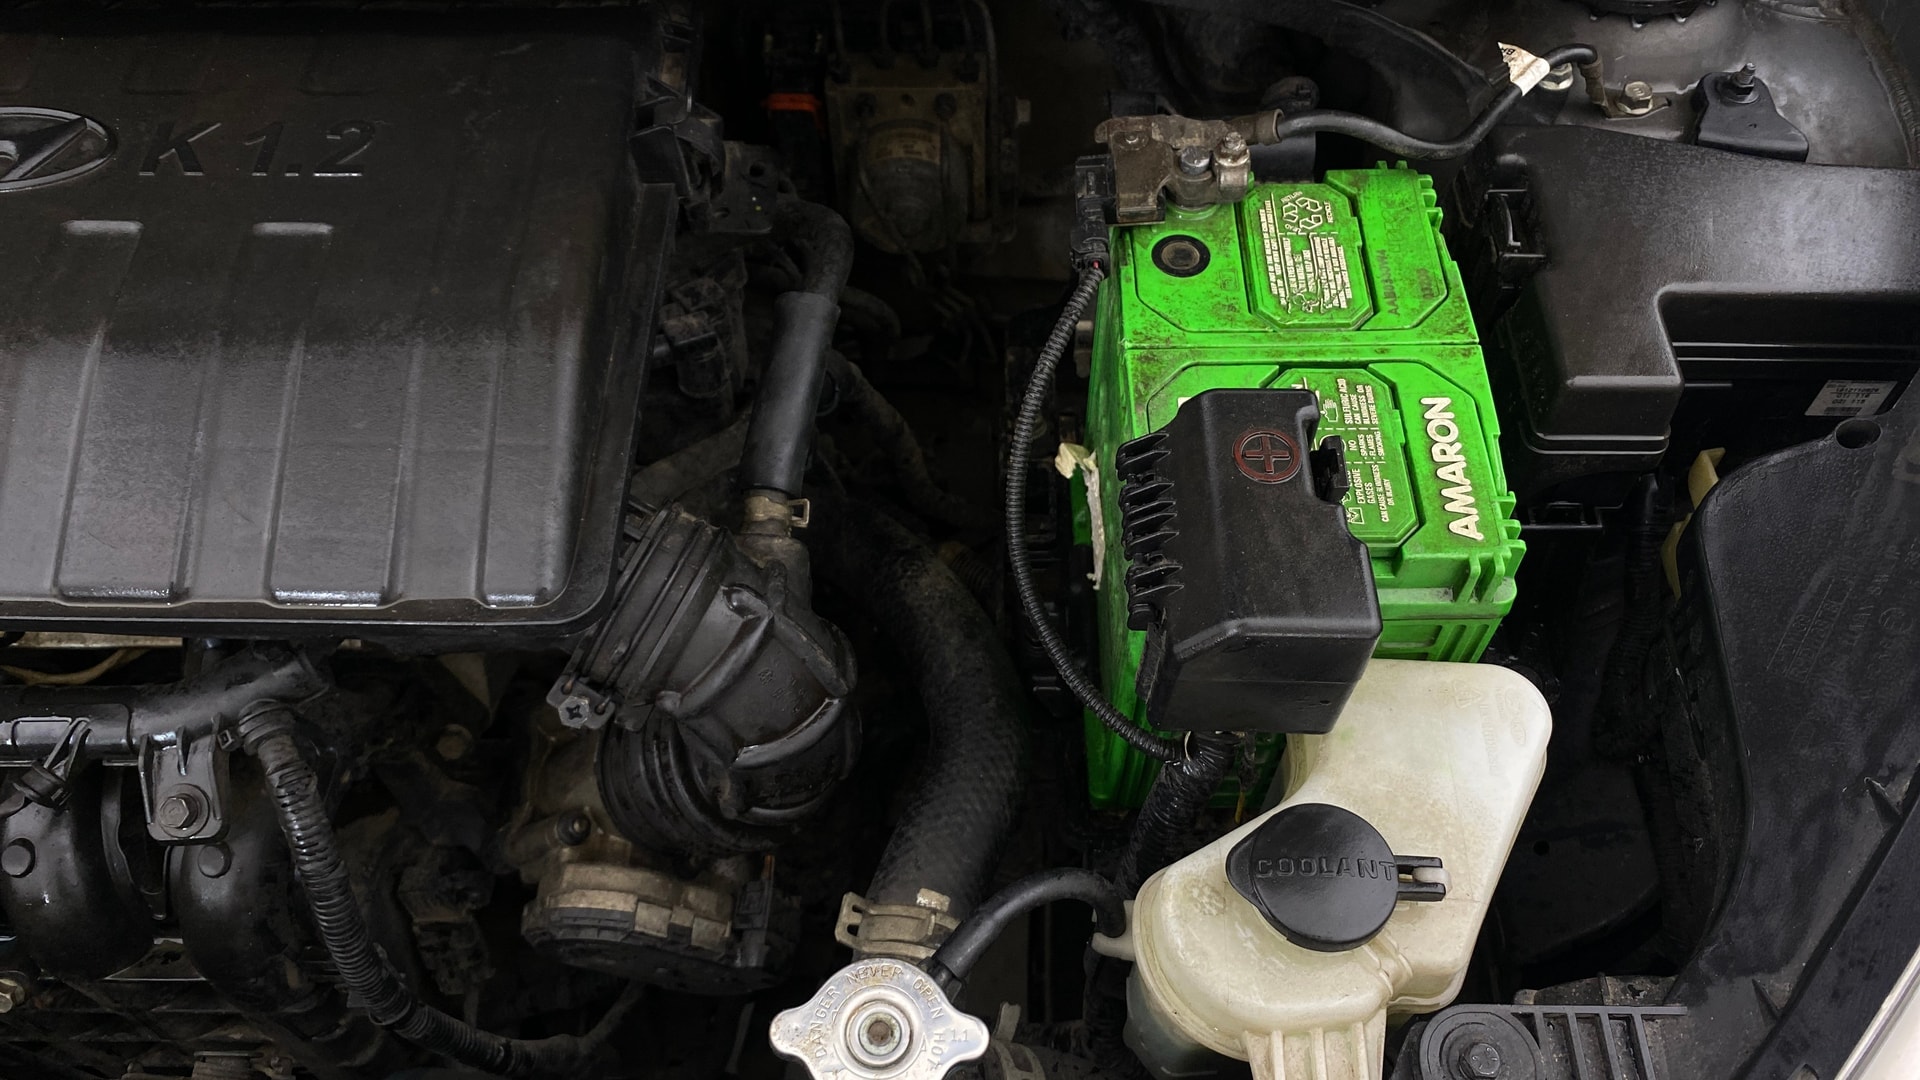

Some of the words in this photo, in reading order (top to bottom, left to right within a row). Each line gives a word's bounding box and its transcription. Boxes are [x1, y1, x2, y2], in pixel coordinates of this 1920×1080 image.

[139, 121, 222, 176] K
[243, 120, 376, 177] 1.2
[1323, 201, 1334, 223] RECYCLE
[1337, 379, 1347, 393] ACID
[1356, 385, 1364, 393] OR
[1365, 385, 1374, 404] BURNS
[1340, 394, 1353, 424] SULFURIC
[1350, 394, 1359, 411] CAUSE
[1358, 395, 1370, 424] BLINDNESS
[1354, 413, 1362, 424] CAN
[1368, 404, 1378, 424] SEVERE
[1348, 439, 1358, 451] NO
[1357, 434, 1368, 456] SPARKS
[1366, 434, 1376, 456] FLAMES
[1374, 431, 1384, 456] SMOKING
[1420, 397, 1484, 541] AMARON
[1352, 468, 1366, 504] EXPLOSIVE
[1364, 482, 1376, 504] GASES
[1383, 478, 1393, 498] INJURY
[1377, 493, 1387, 510] CAUSE
[1386, 498, 1395, 506] OR
[1381, 510, 1389, 522] CAN
[1255, 856, 1396, 881] COOLANT
[846, 964, 904, 984] NEVER
[912, 976, 945, 1020] OPEN
[809, 985, 841, 1059] DANGER
[927, 1031, 946, 1070] HOT
